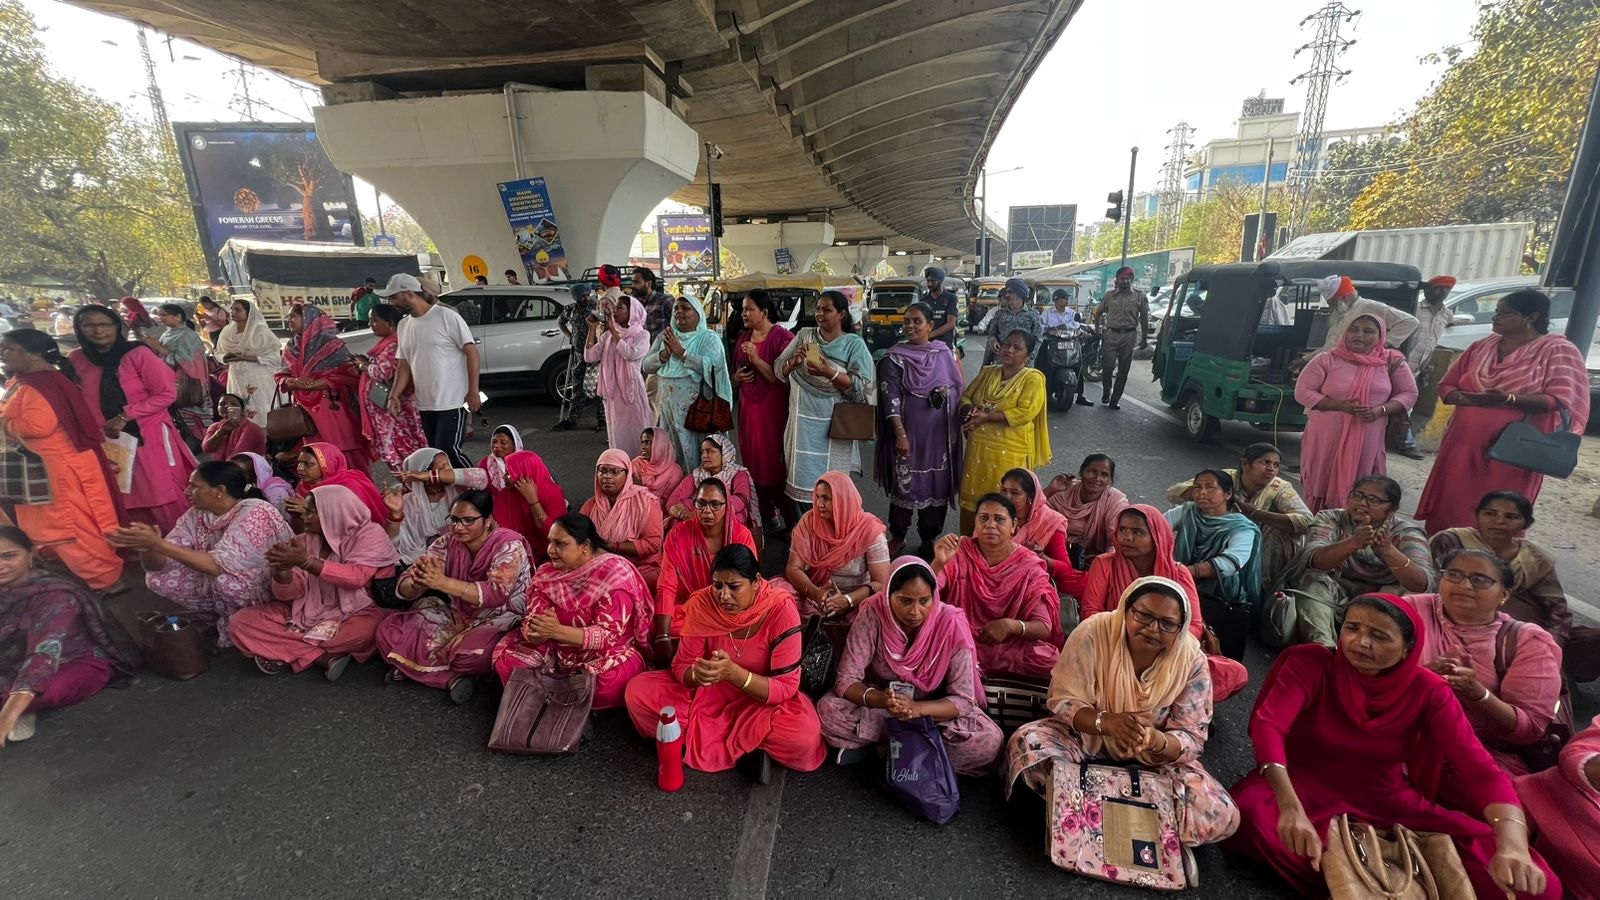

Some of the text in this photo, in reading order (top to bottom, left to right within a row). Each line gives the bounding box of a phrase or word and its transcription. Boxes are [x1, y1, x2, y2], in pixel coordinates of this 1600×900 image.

[255, 215, 284, 223] GREENS
[469, 265, 480, 274] 16
[306, 296, 329, 306] SAN
